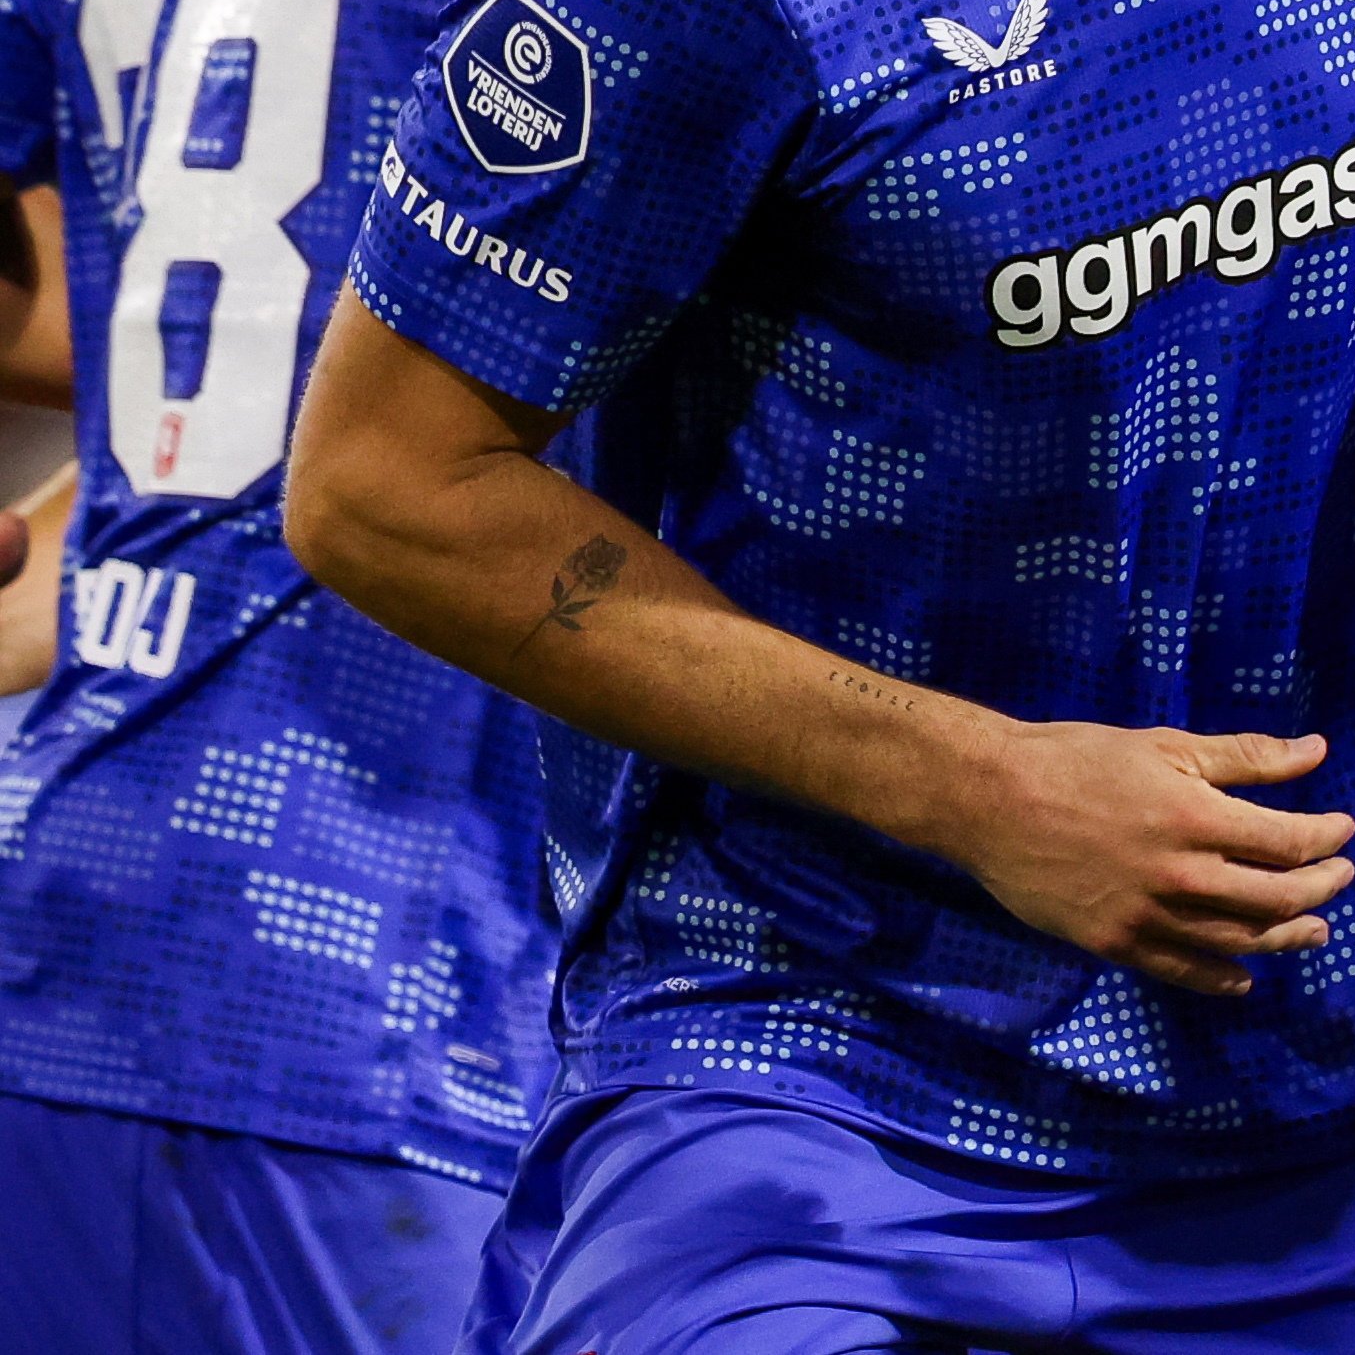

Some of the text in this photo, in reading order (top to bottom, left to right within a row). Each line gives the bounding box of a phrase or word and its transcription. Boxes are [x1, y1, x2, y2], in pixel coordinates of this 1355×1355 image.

[468, 59, 562, 141] VRIENDEN
[949, 59, 1057, 104] CASTORE
[467, 92, 542, 151] LOTERIJ
[401, 175, 573, 303] TAURUS
